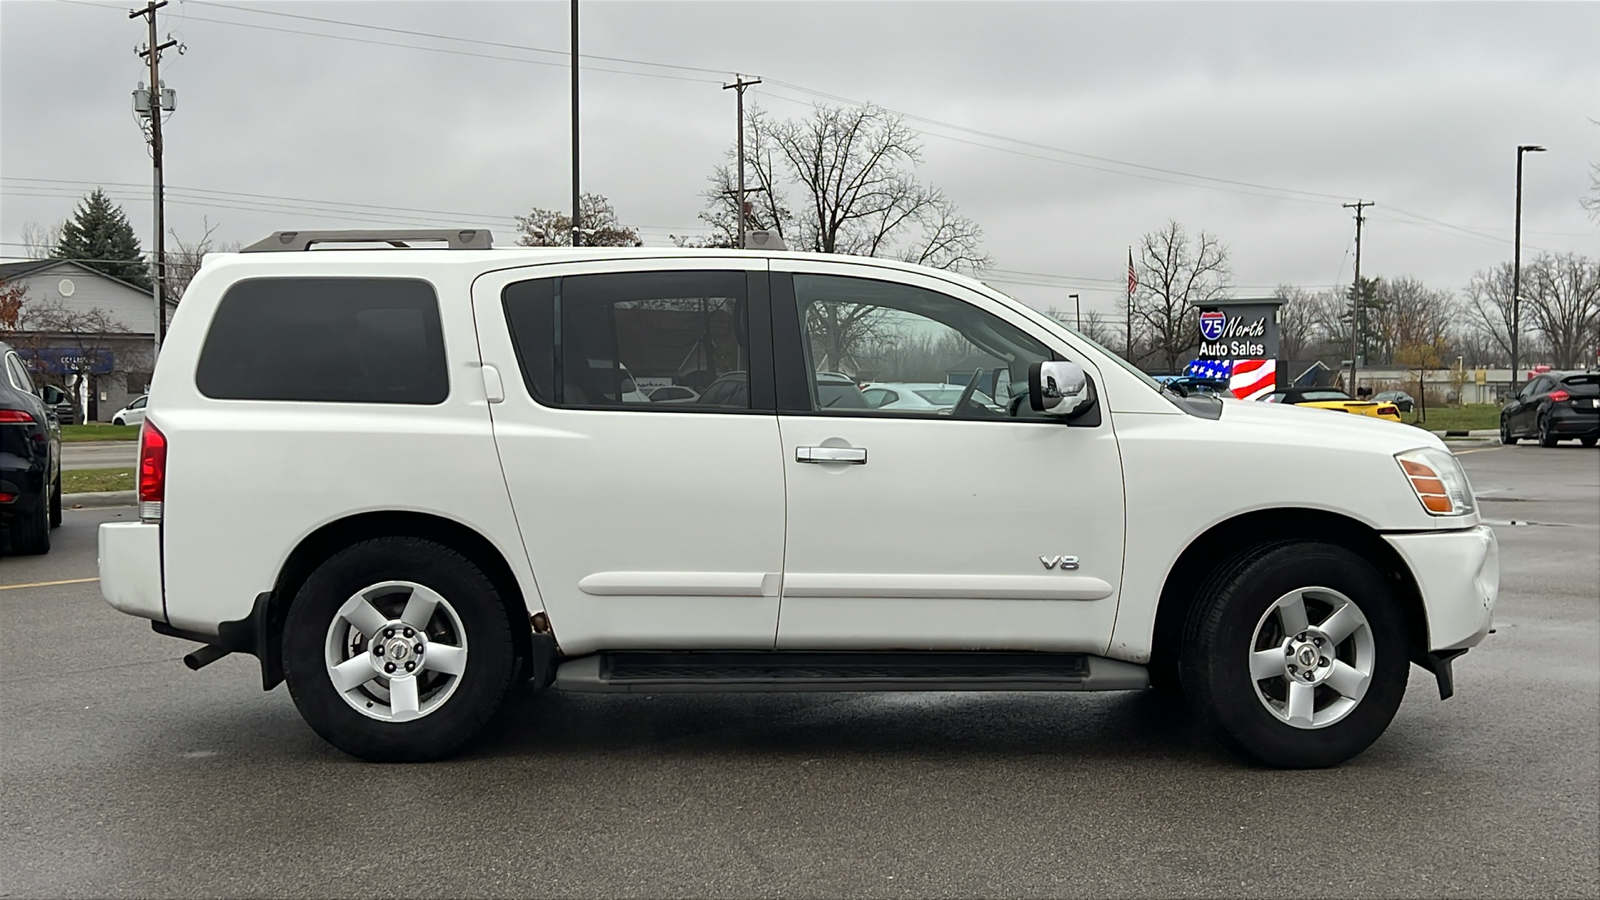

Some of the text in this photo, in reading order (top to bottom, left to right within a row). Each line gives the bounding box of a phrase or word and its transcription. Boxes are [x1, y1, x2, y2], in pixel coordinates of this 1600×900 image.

[1204, 316, 1265, 338] 75 North
[1199, 341, 1264, 356] Auto Sales
[1039, 555, 1079, 570] V8
